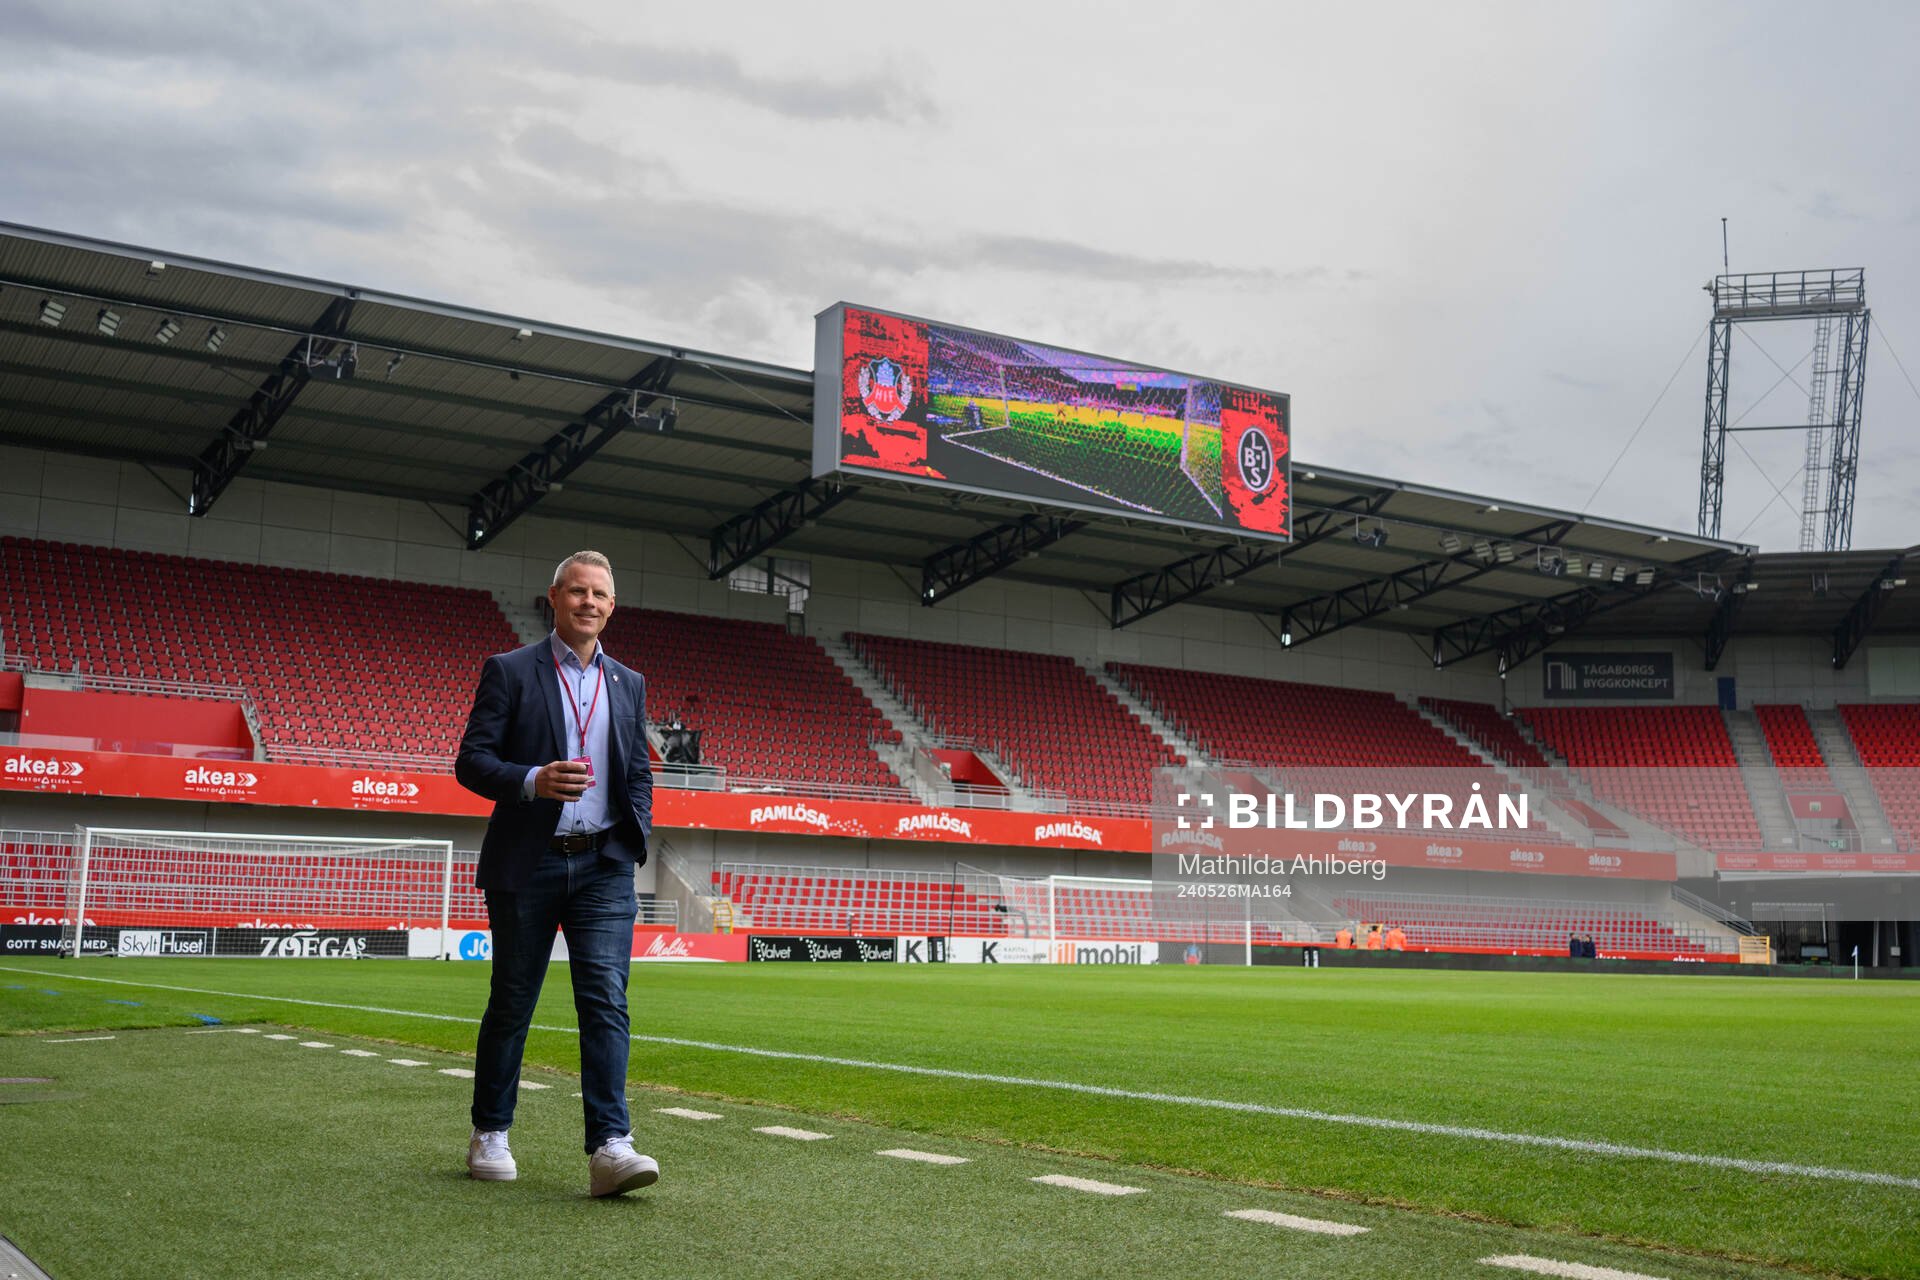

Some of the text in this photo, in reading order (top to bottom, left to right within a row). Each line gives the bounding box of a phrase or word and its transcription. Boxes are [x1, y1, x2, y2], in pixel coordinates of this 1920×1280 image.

[1583, 678, 1669, 689] BYGGKONCEPT
[4, 755, 60, 775] akea
[184, 766, 236, 786] akea
[351, 776, 399, 796] akea
[750, 803, 829, 830] RAMLÖSA
[898, 812, 971, 838] RAMLÖSA
[1035, 820, 1102, 845] RAMLÖSA
[1338, 838, 1365, 852] akea
[1426, 843, 1452, 858] akea
[1510, 848, 1534, 862] akea
[1588, 854, 1612, 866] akea
[6, 940, 37, 949] GOTT
[83, 940, 108, 949] MED
